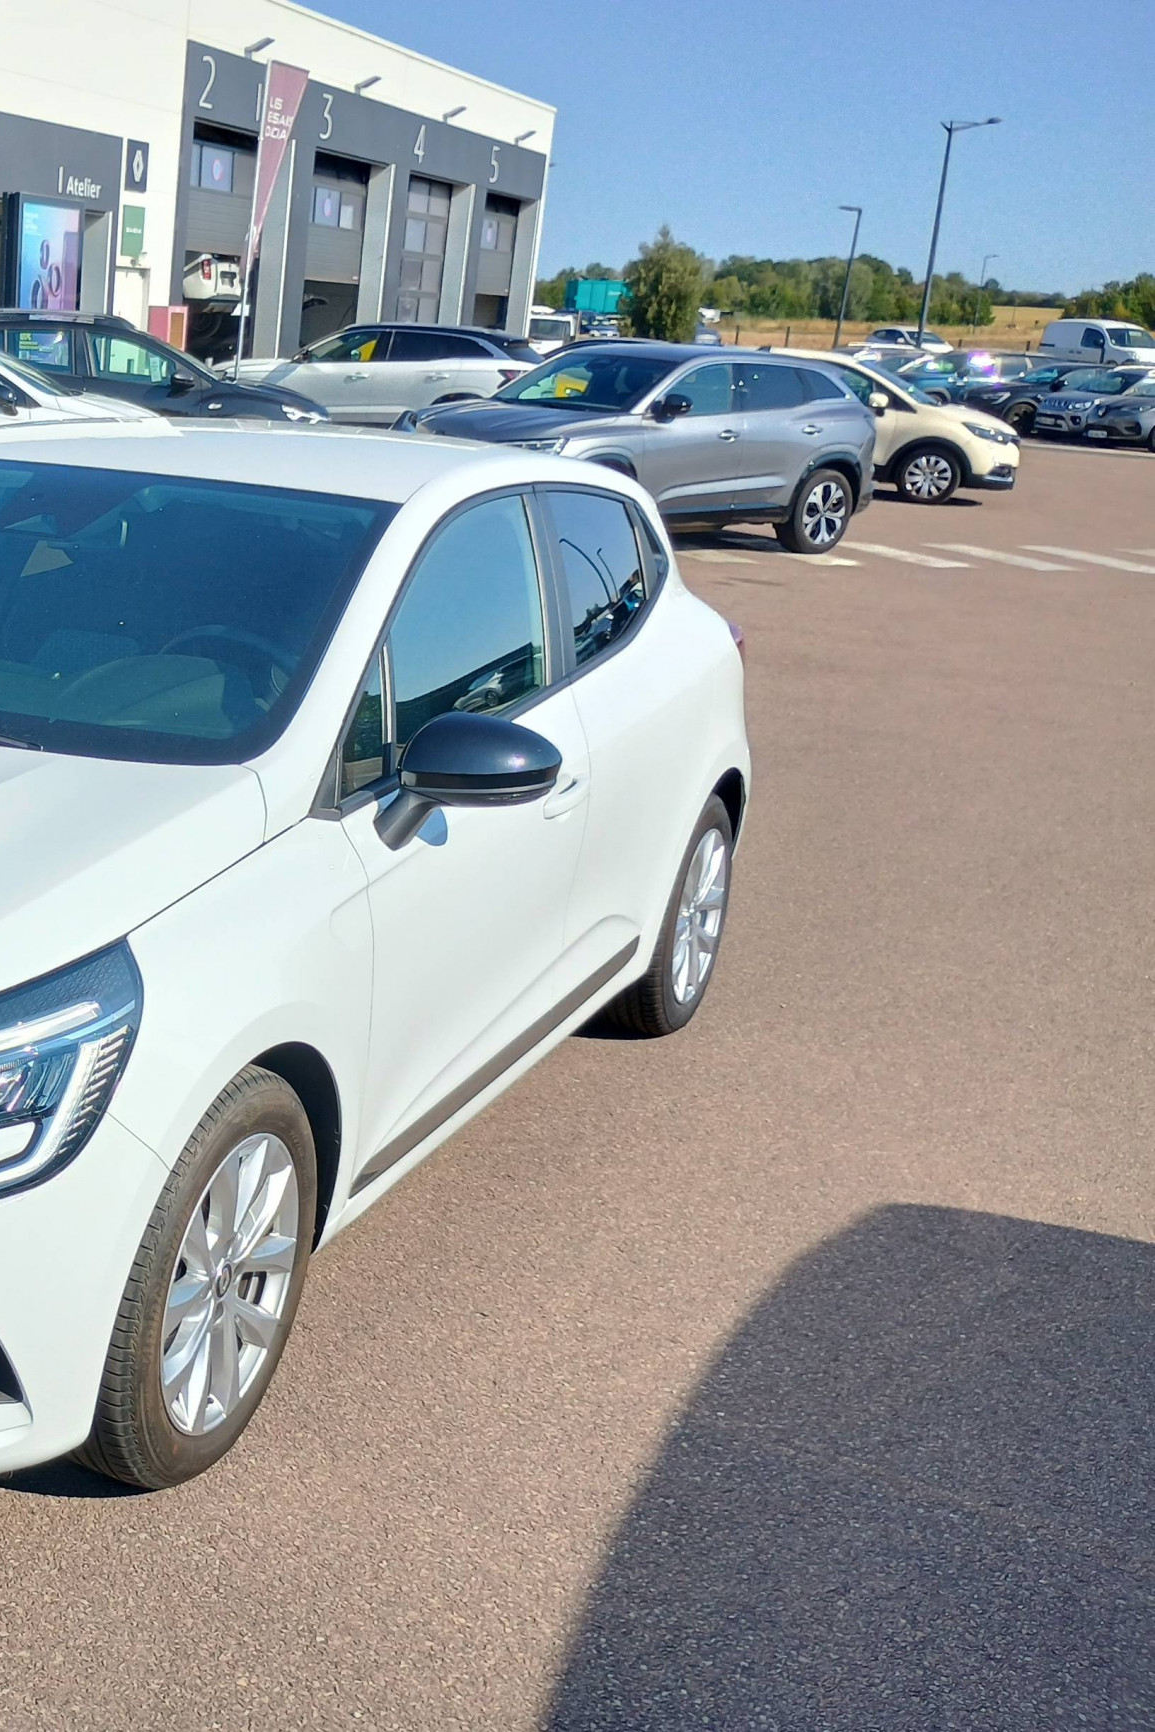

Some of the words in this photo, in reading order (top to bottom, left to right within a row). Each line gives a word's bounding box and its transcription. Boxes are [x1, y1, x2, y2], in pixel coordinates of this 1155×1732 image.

[198, 55, 216, 109] 2
[319, 93, 334, 140] 3
[413, 124, 426, 164] 4
[489, 145, 501, 184] 5
[66, 175, 102, 199] Atelier
